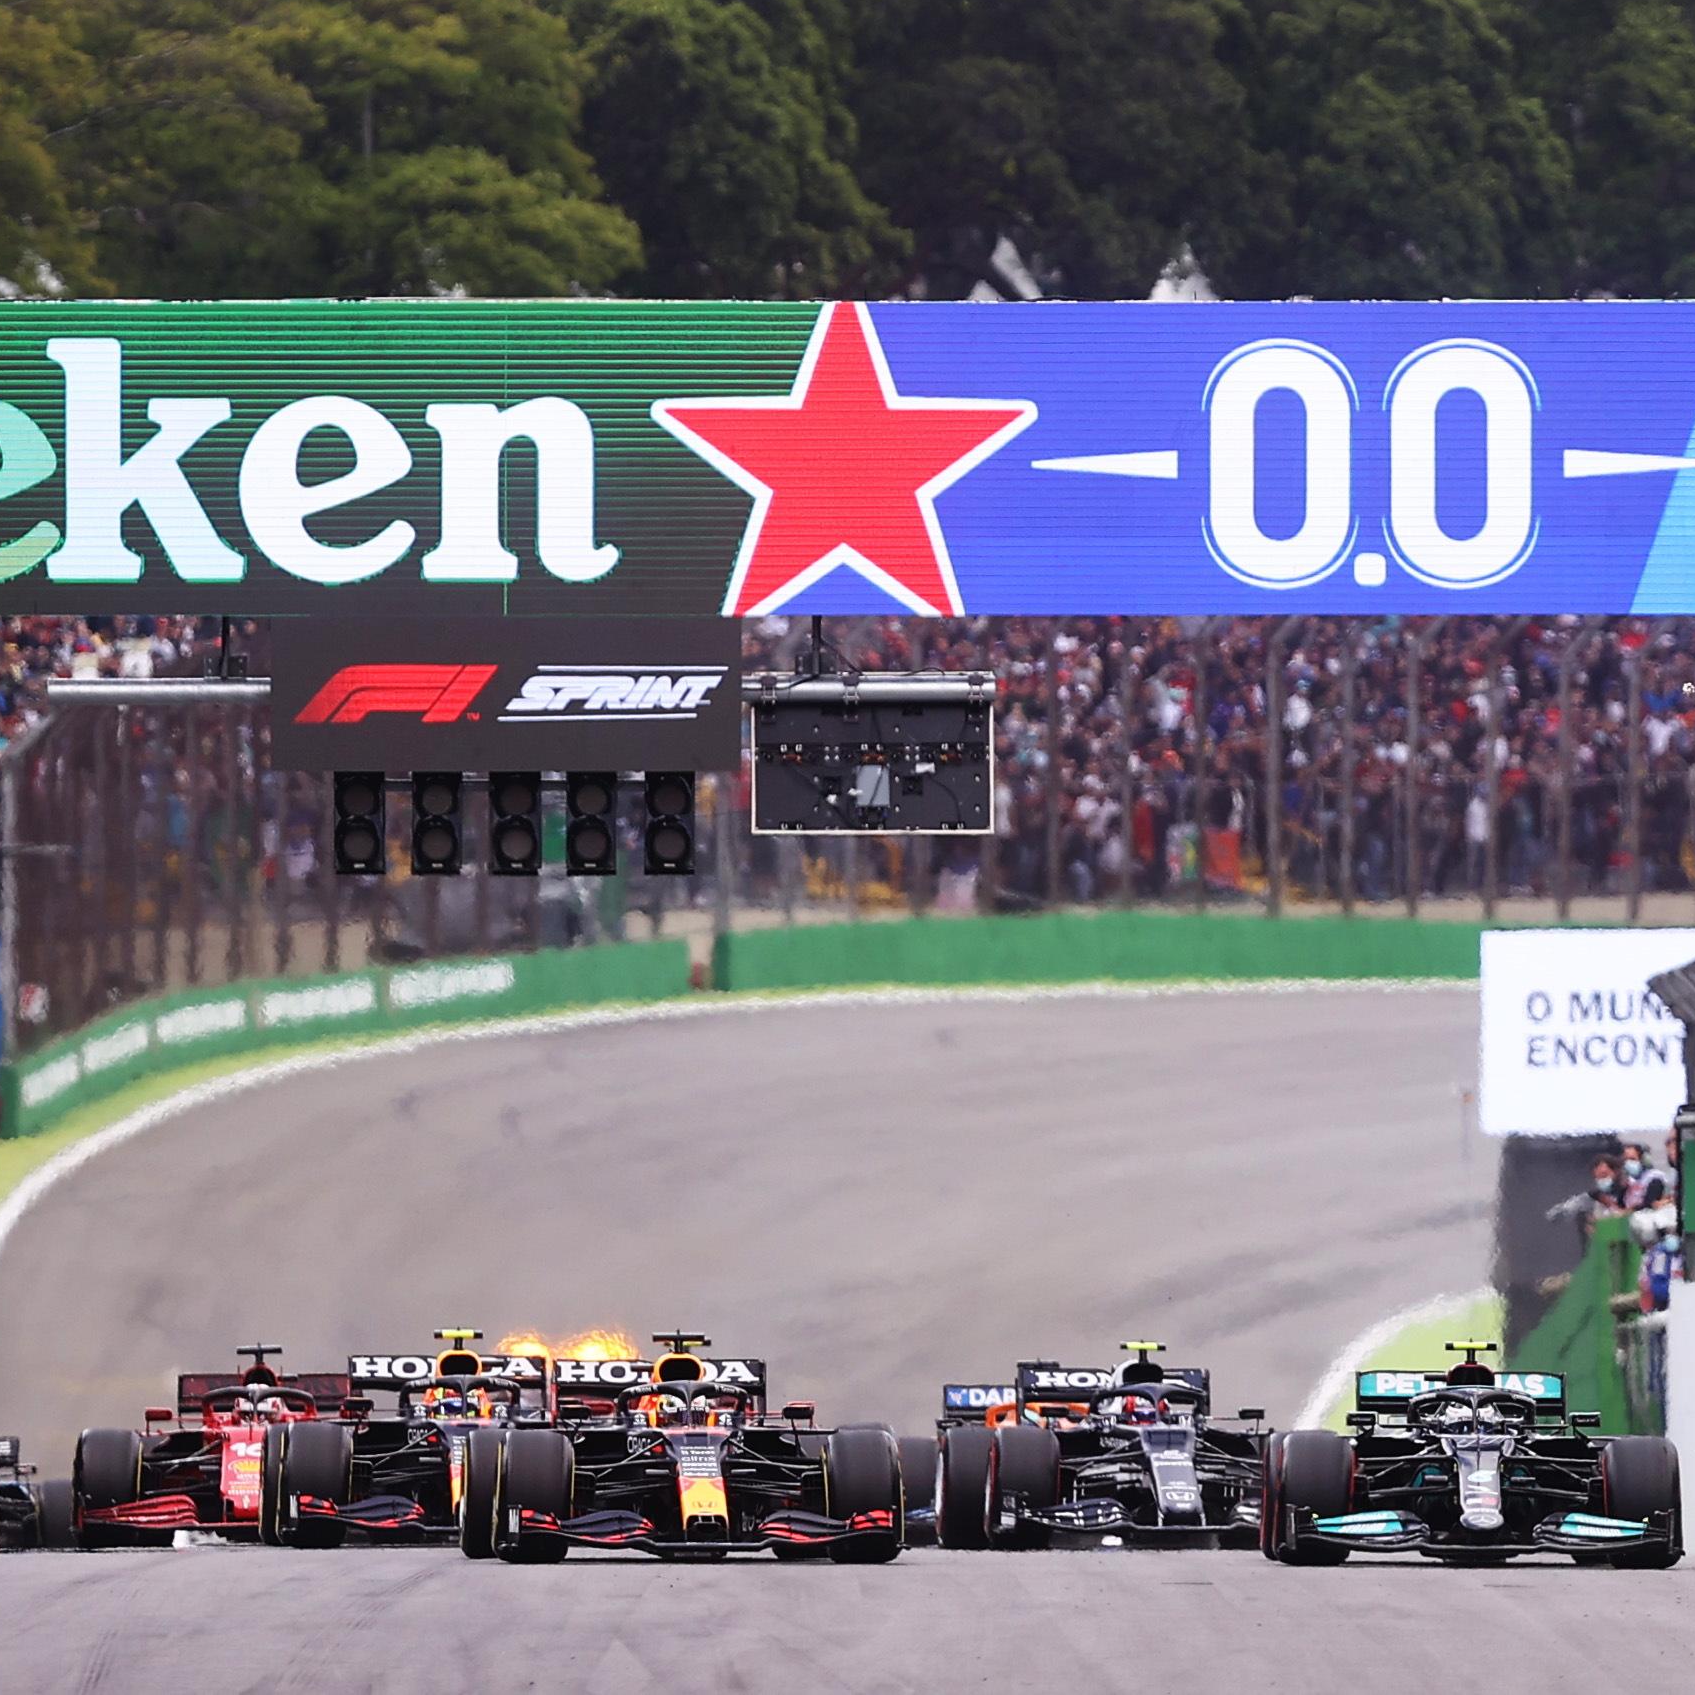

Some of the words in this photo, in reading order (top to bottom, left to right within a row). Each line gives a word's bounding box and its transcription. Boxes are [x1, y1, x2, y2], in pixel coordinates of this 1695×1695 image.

[1202, 337, 1541, 589] 0.0
[505, 675, 723, 711] SPRINT
[1527, 990, 1552, 1022] O
[1569, 990, 1674, 1022] MUN
